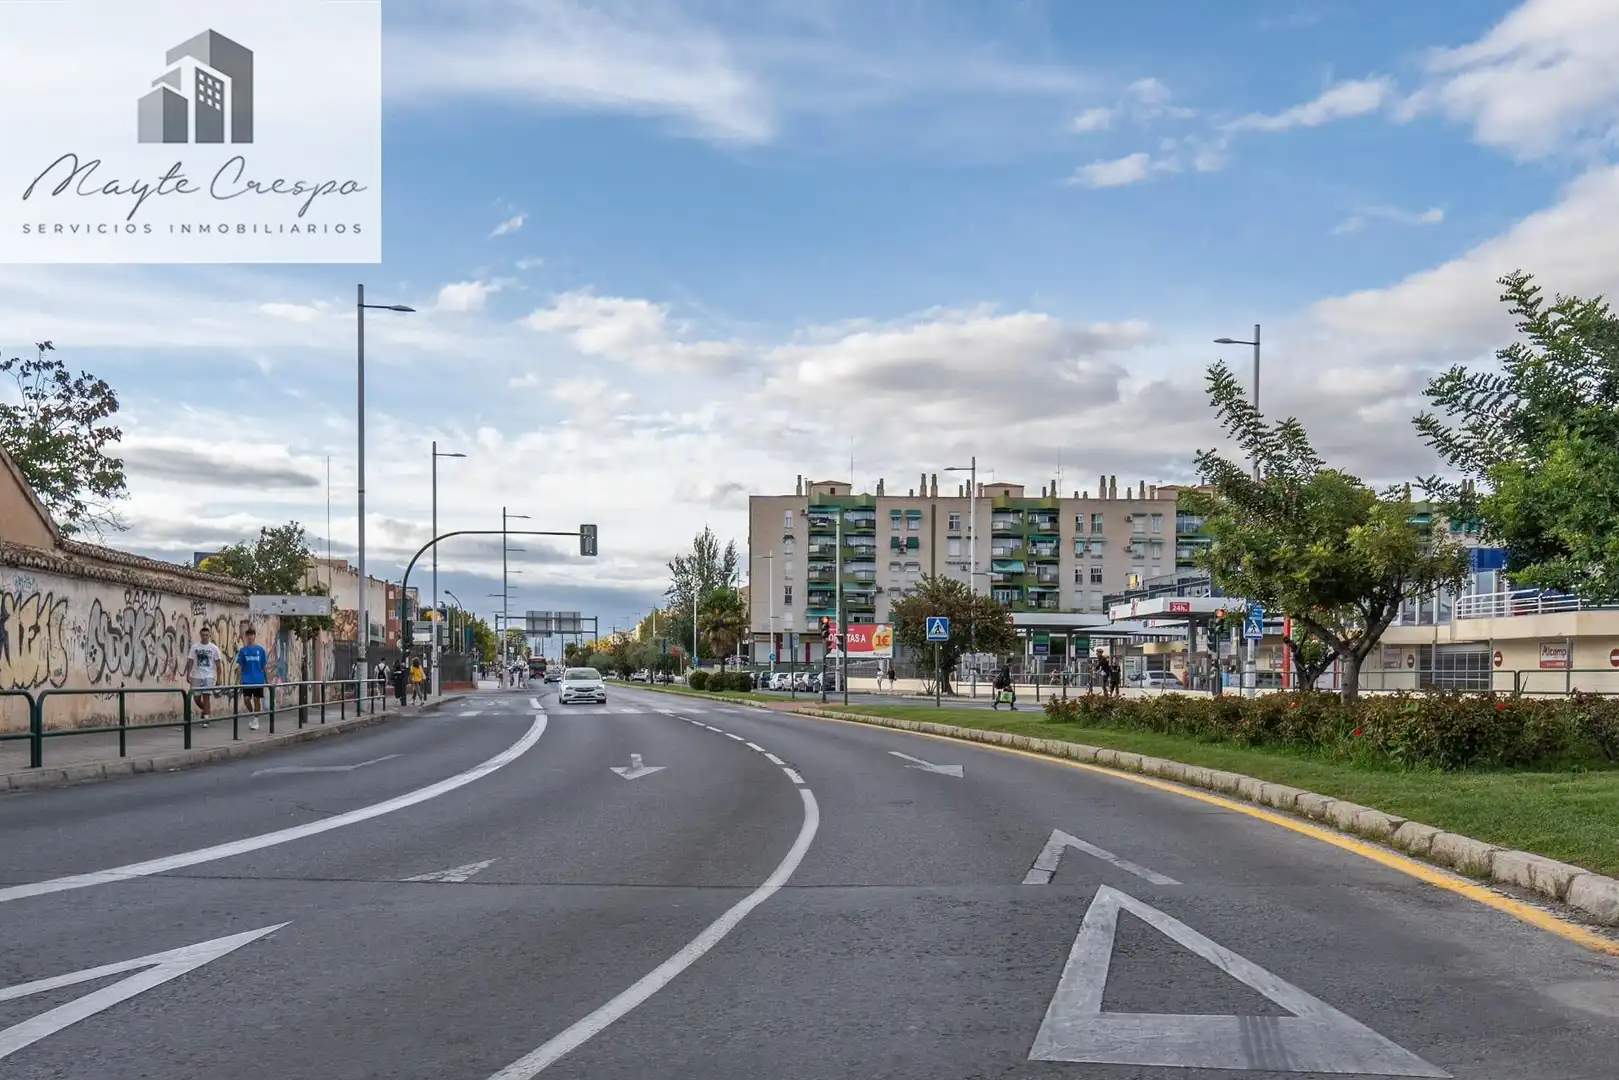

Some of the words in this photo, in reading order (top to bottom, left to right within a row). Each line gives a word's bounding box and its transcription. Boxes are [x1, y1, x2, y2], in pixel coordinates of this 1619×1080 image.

[860, 633, 866, 643] A
[875, 635, 890, 647] 1€
[1541, 645, 1567, 659] Alcamp
